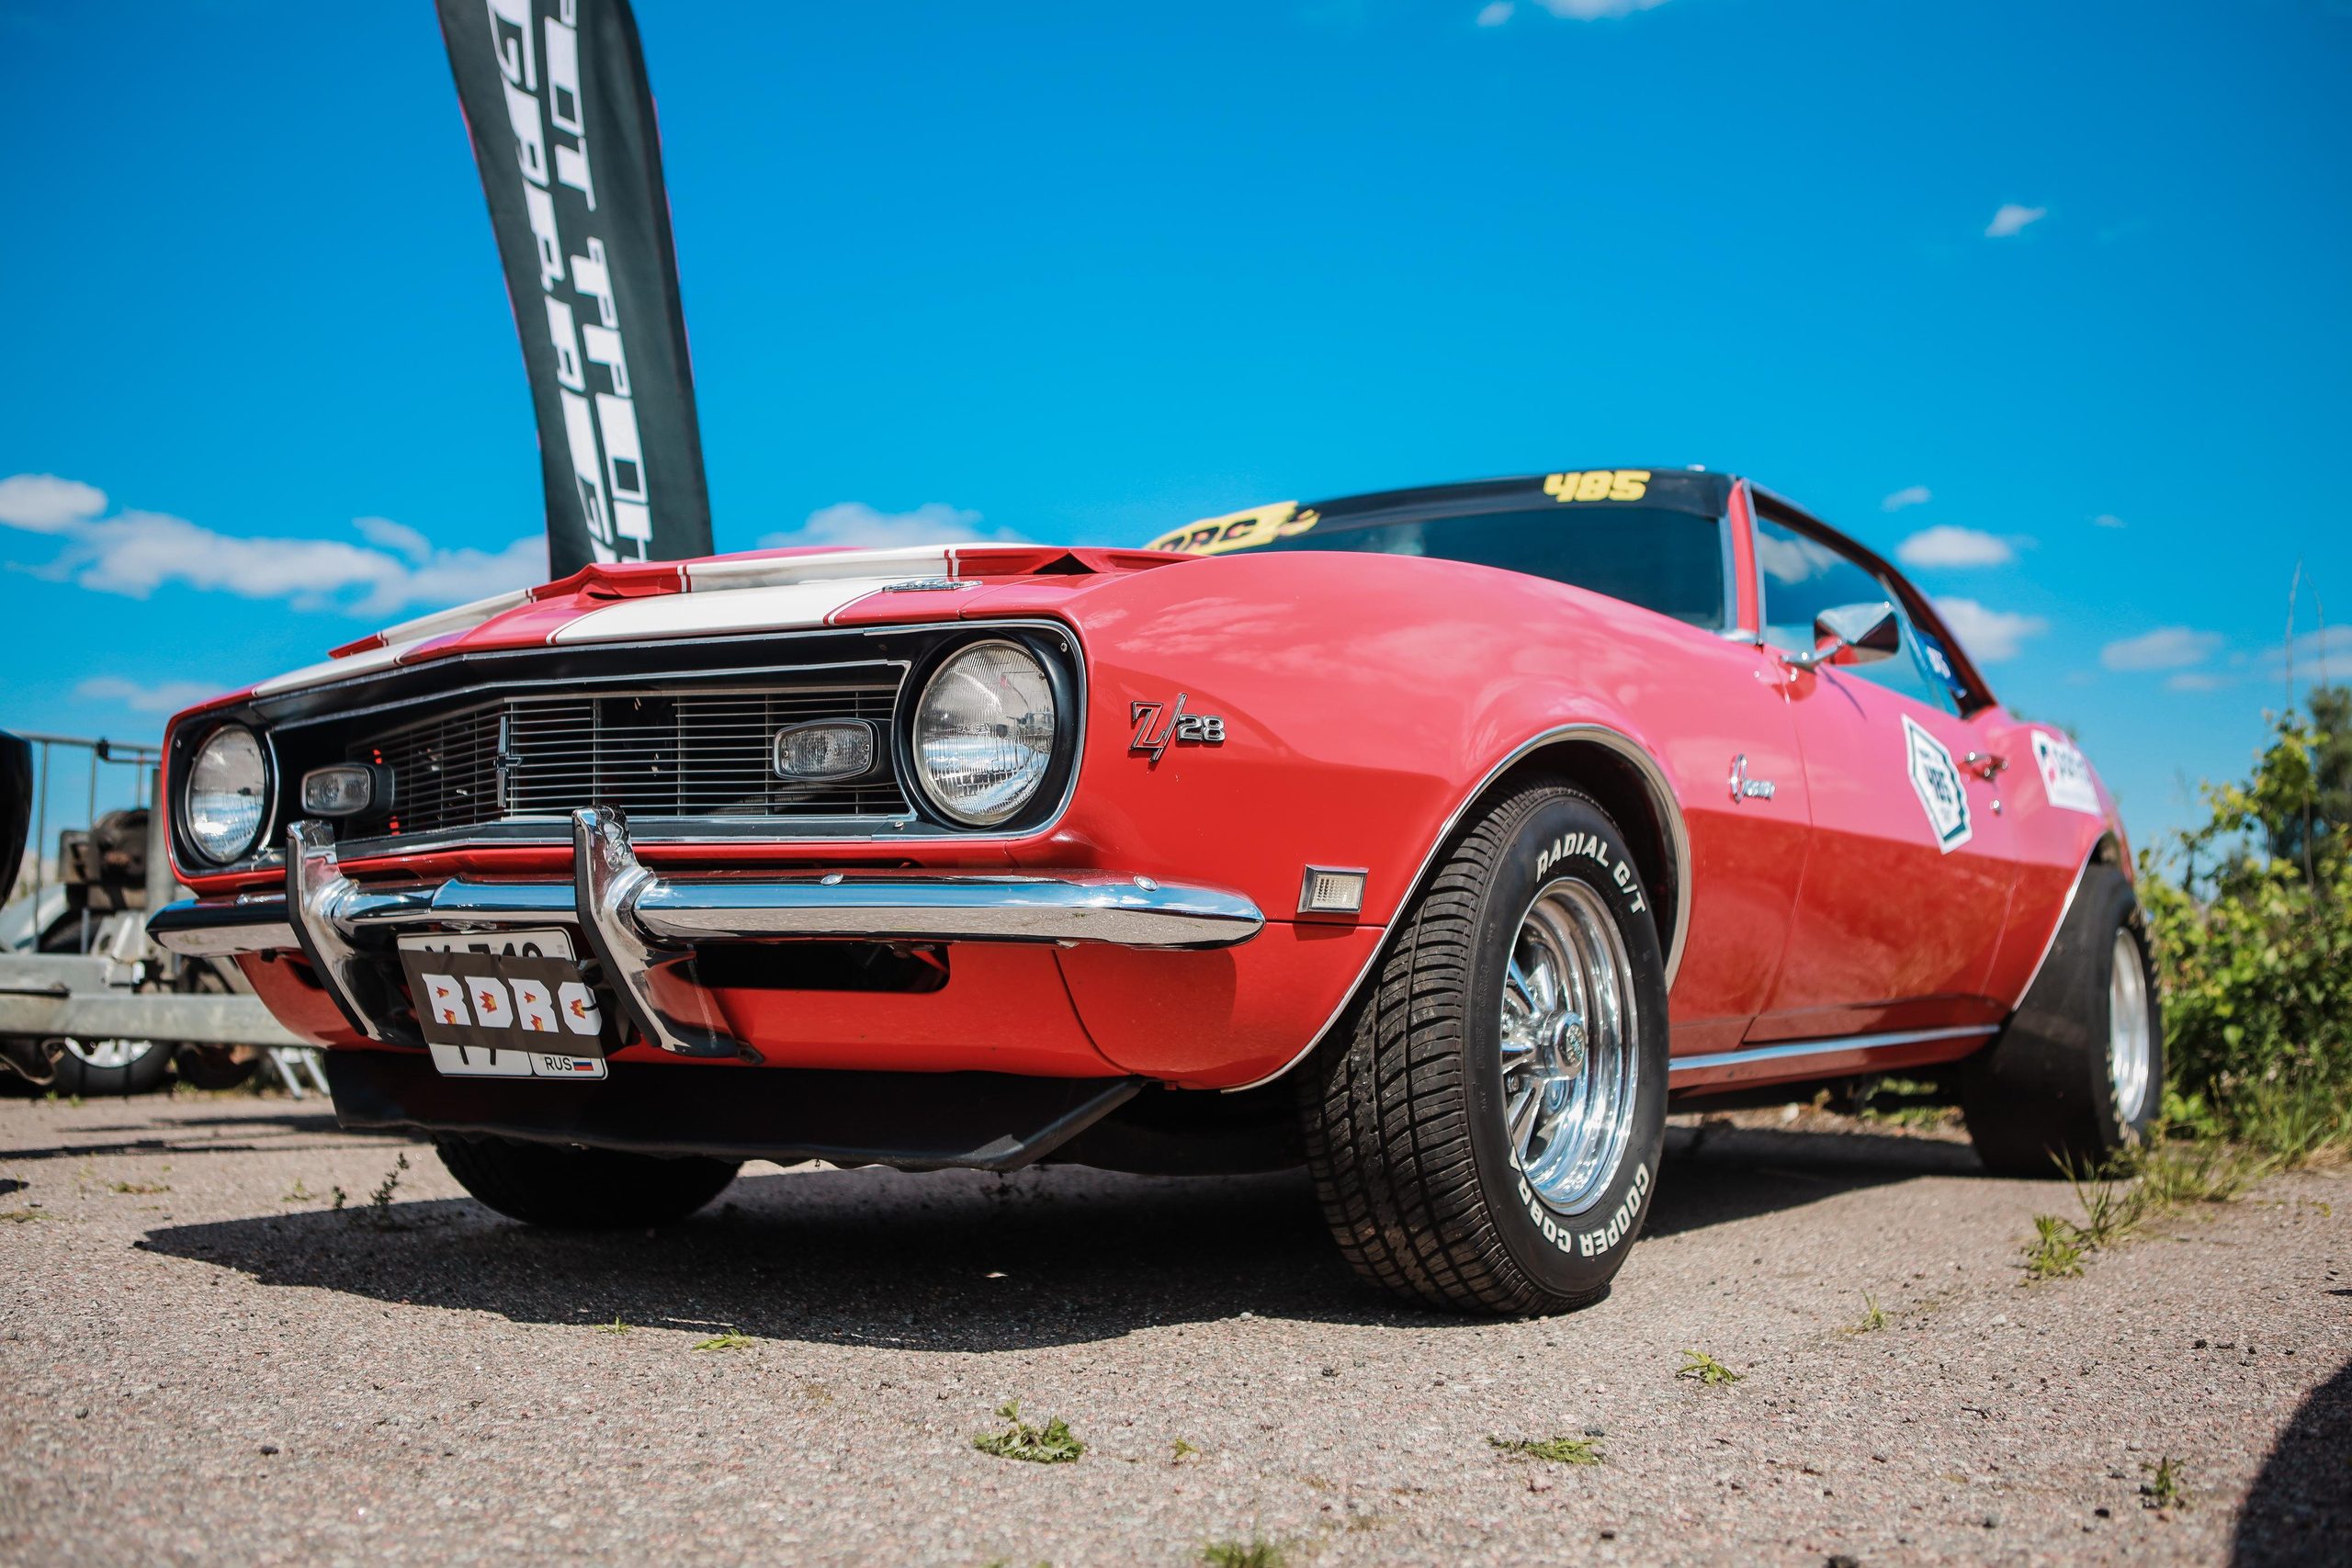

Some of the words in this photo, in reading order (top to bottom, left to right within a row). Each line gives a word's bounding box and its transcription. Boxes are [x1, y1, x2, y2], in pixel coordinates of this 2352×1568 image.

[1544, 469, 1651, 502] 485
[1129, 694, 1226, 761] Z/28
[1536, 832, 1610, 883] RADIAL
[1613, 860, 1646, 914] G/T
[422, 973, 603, 1036] RDRC
[545, 1056, 571, 1071] RUS
[1579, 1163, 1650, 1258] COOPER
